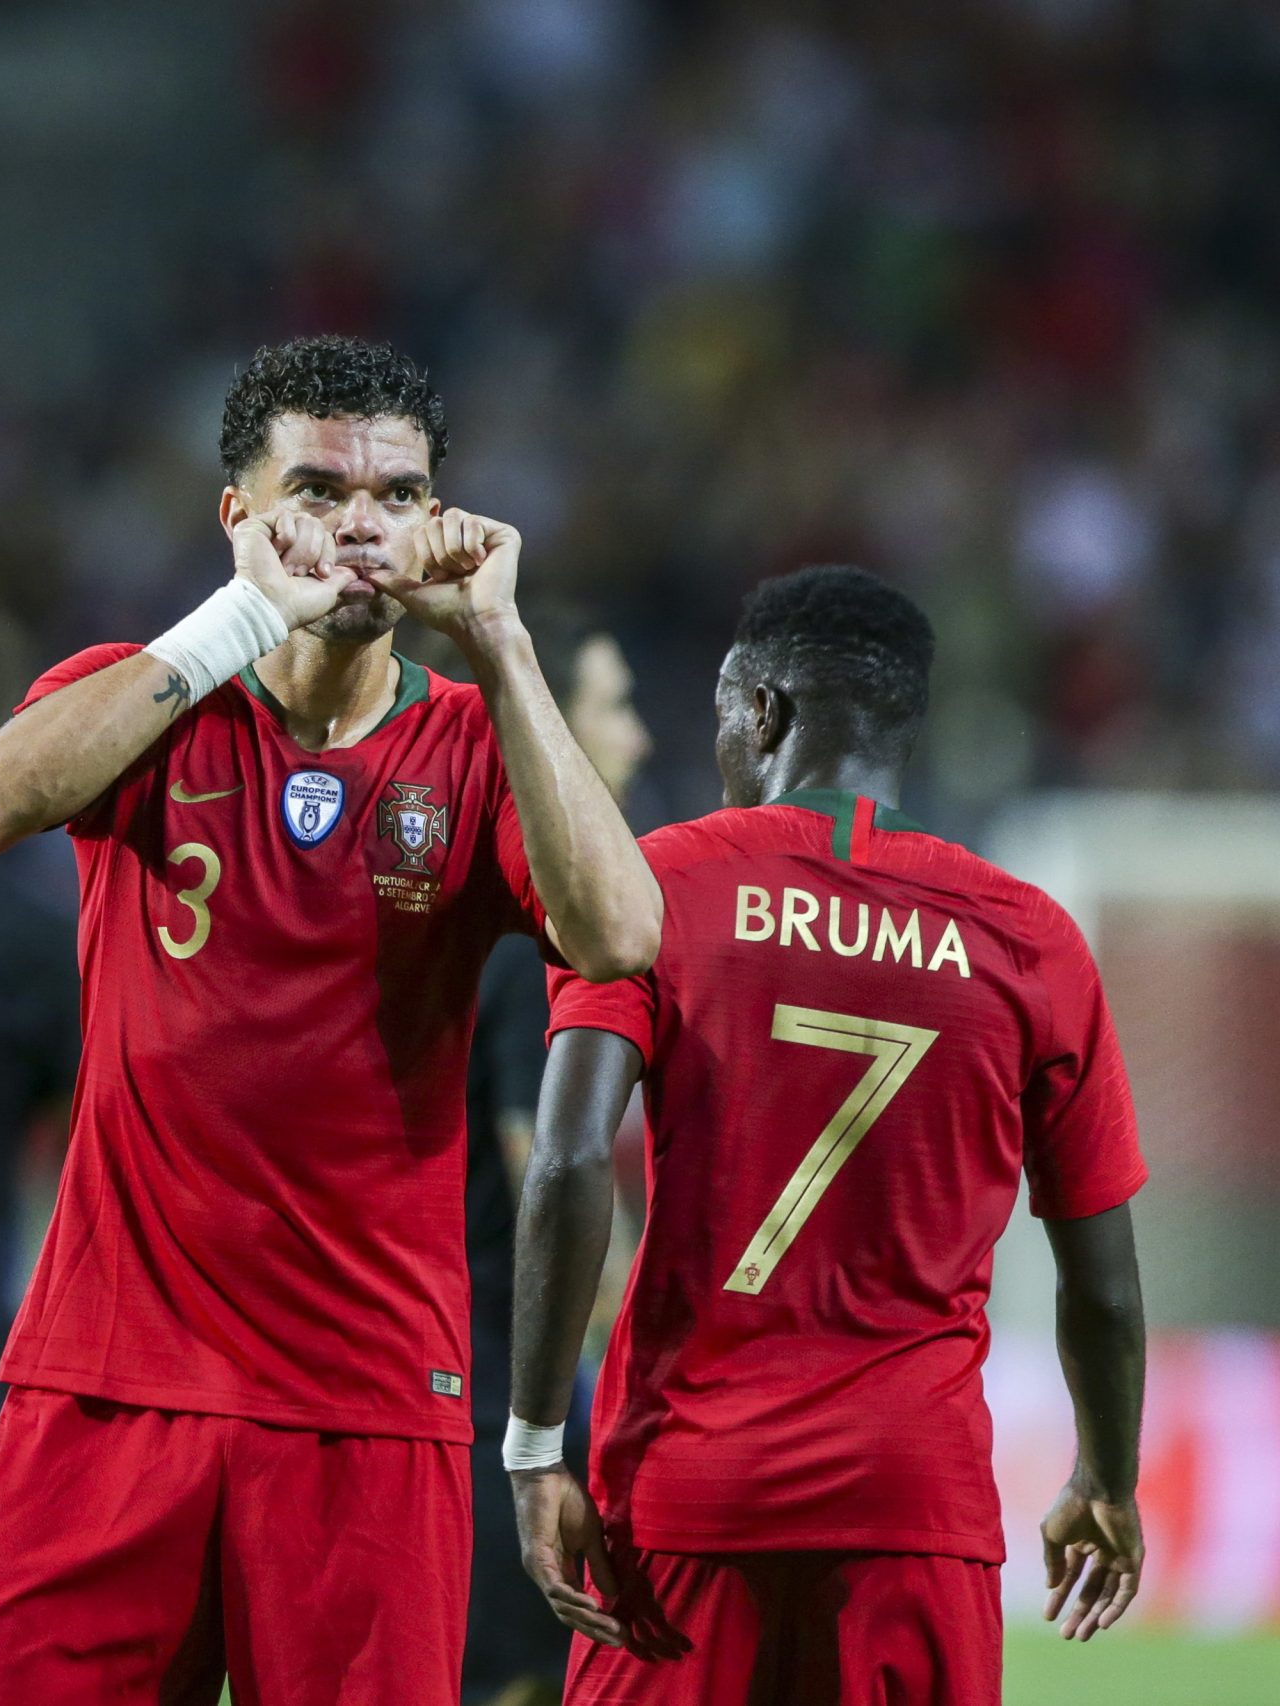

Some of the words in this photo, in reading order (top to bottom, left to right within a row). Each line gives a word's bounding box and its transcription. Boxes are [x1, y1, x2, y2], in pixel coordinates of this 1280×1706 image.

[304, 776, 328, 786] UEFA
[289, 792, 337, 803] CHAMPIONS
[291, 785, 338, 796] EUROPEAN
[157, 842, 221, 959] 3
[378, 887, 385, 896] 6
[387, 887, 429, 902] SETEMBRO
[394, 900, 431, 914] ALGARVE
[734, 885, 971, 978] BRUMA
[722, 1003, 941, 1295] 7
